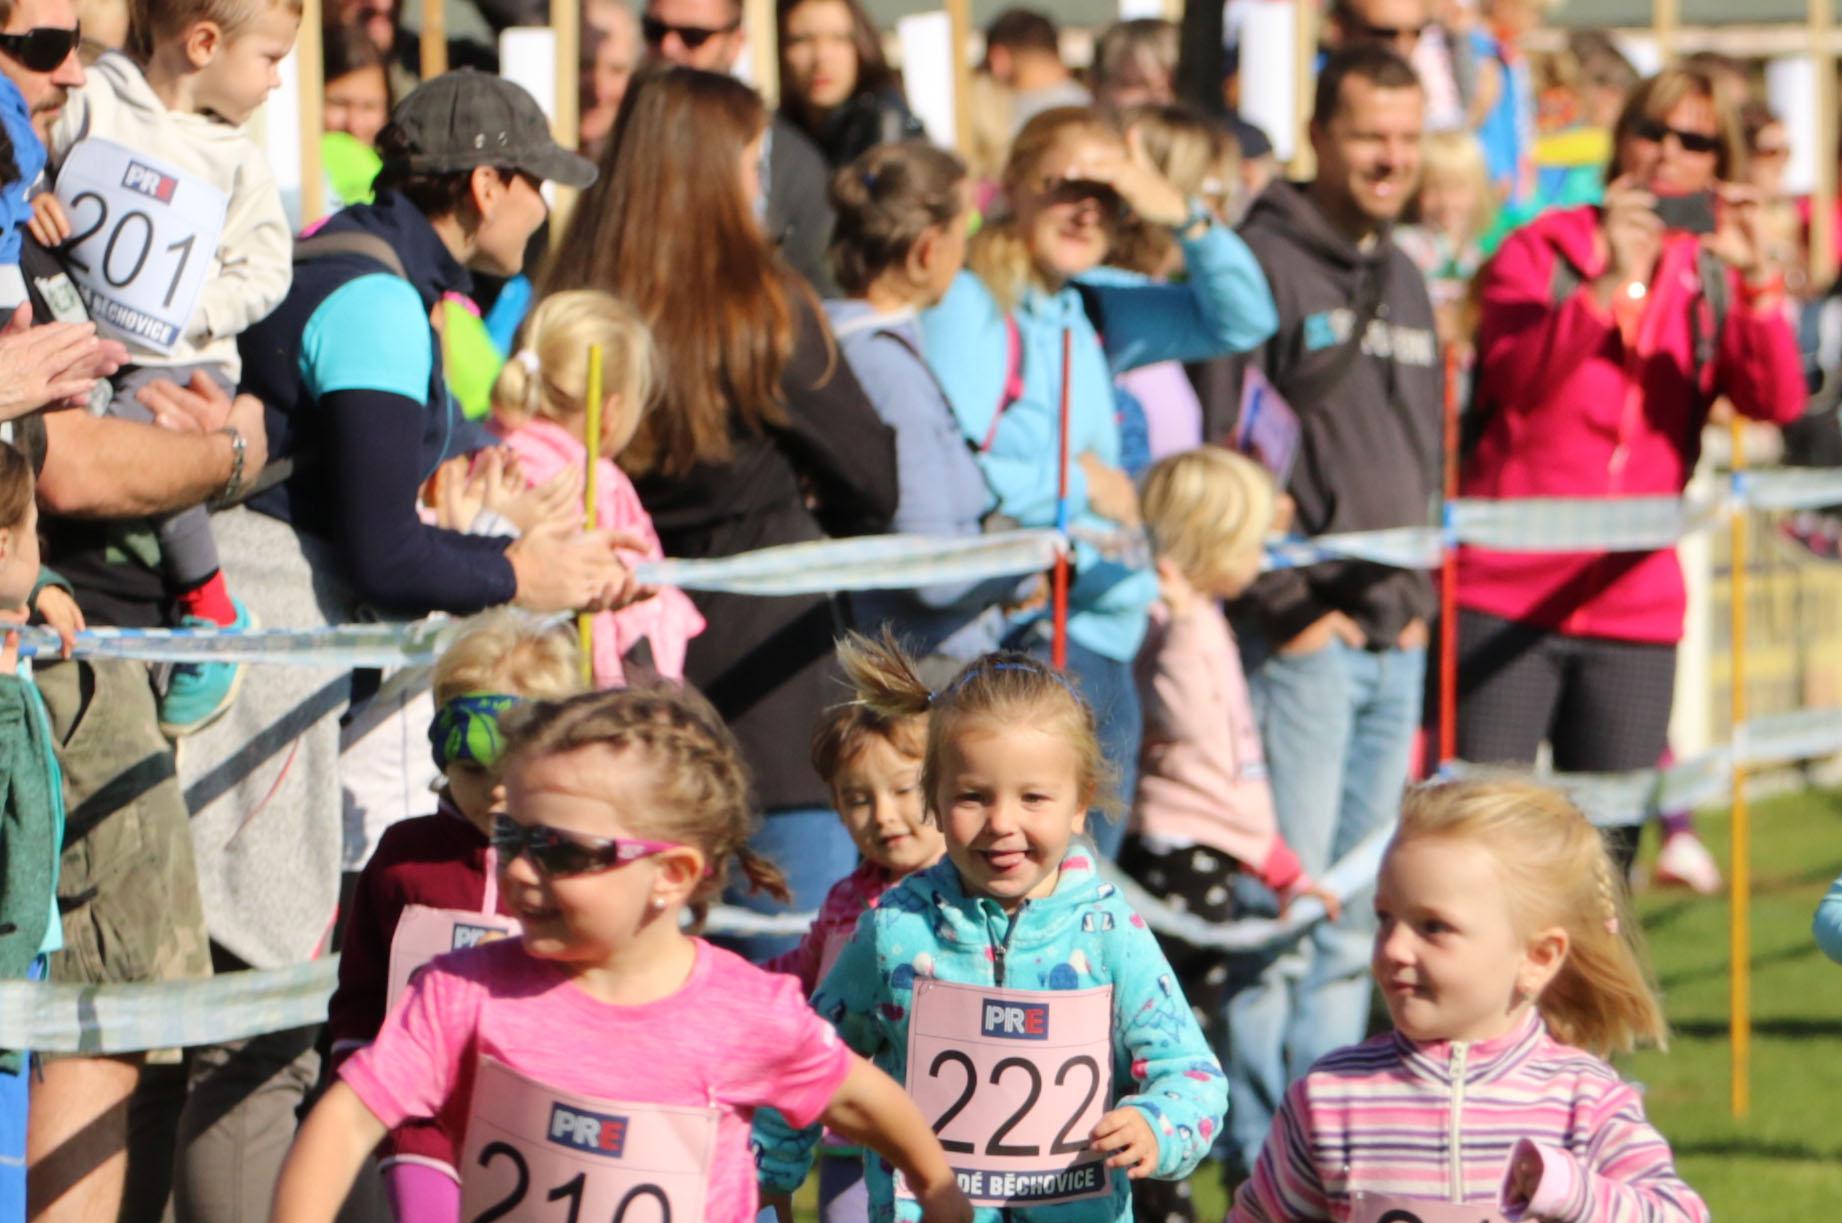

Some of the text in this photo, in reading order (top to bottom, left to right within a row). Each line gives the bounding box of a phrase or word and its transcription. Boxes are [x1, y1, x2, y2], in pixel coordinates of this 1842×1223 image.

[57, 191, 195, 309] 201
[985, 1005, 1045, 1034] PRE
[552, 1109, 624, 1152] PRE
[929, 1049, 1101, 1156] 222
